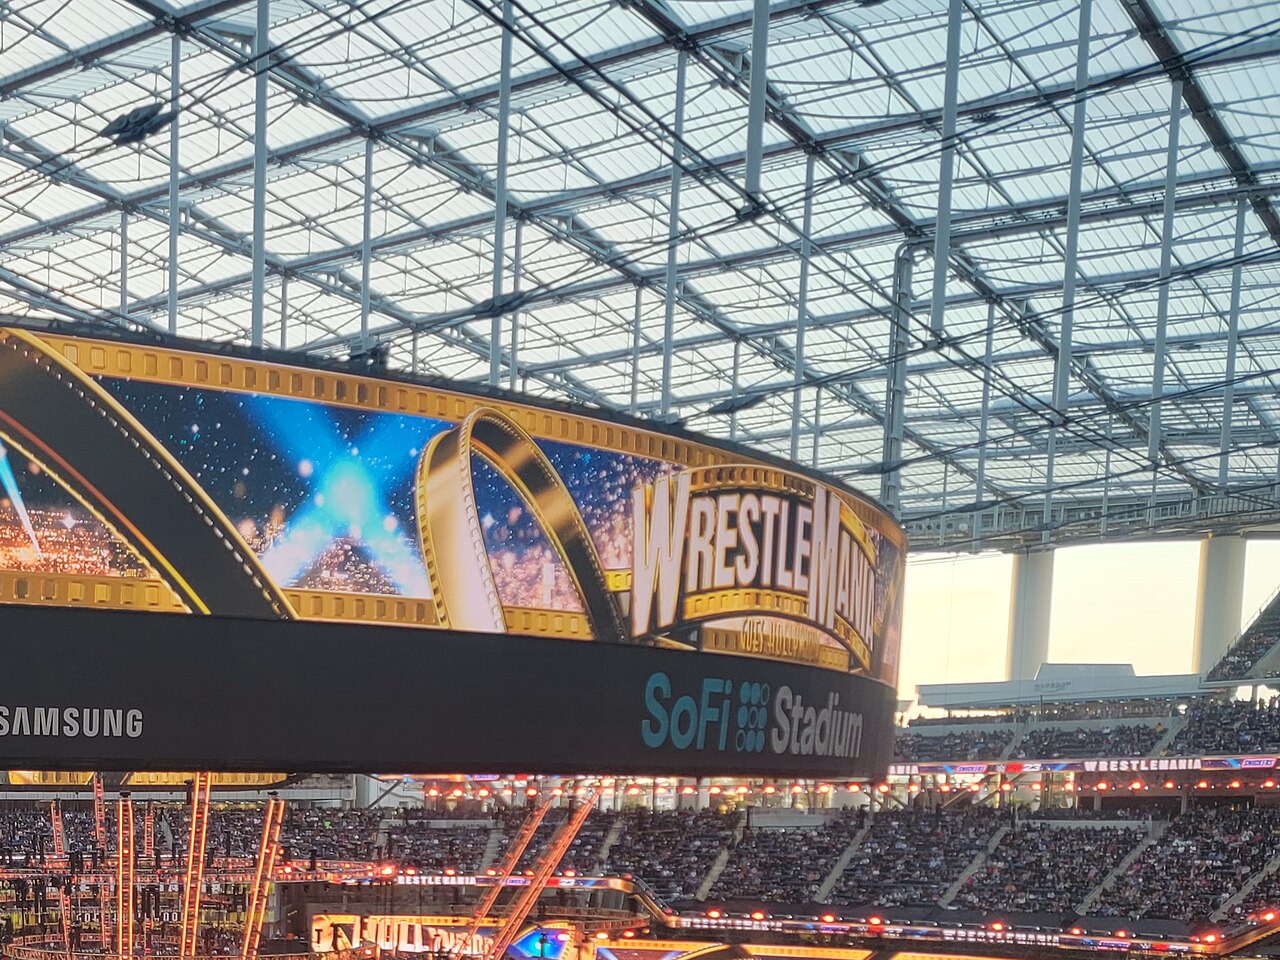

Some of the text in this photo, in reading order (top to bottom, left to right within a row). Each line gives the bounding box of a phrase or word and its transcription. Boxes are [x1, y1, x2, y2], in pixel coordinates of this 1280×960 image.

[641, 672, 864, 759] SoFi Stadium
[1084, 758, 1201, 772] WRESTLEMANIA
[397, 875, 477, 885] RESTLEMANIA
